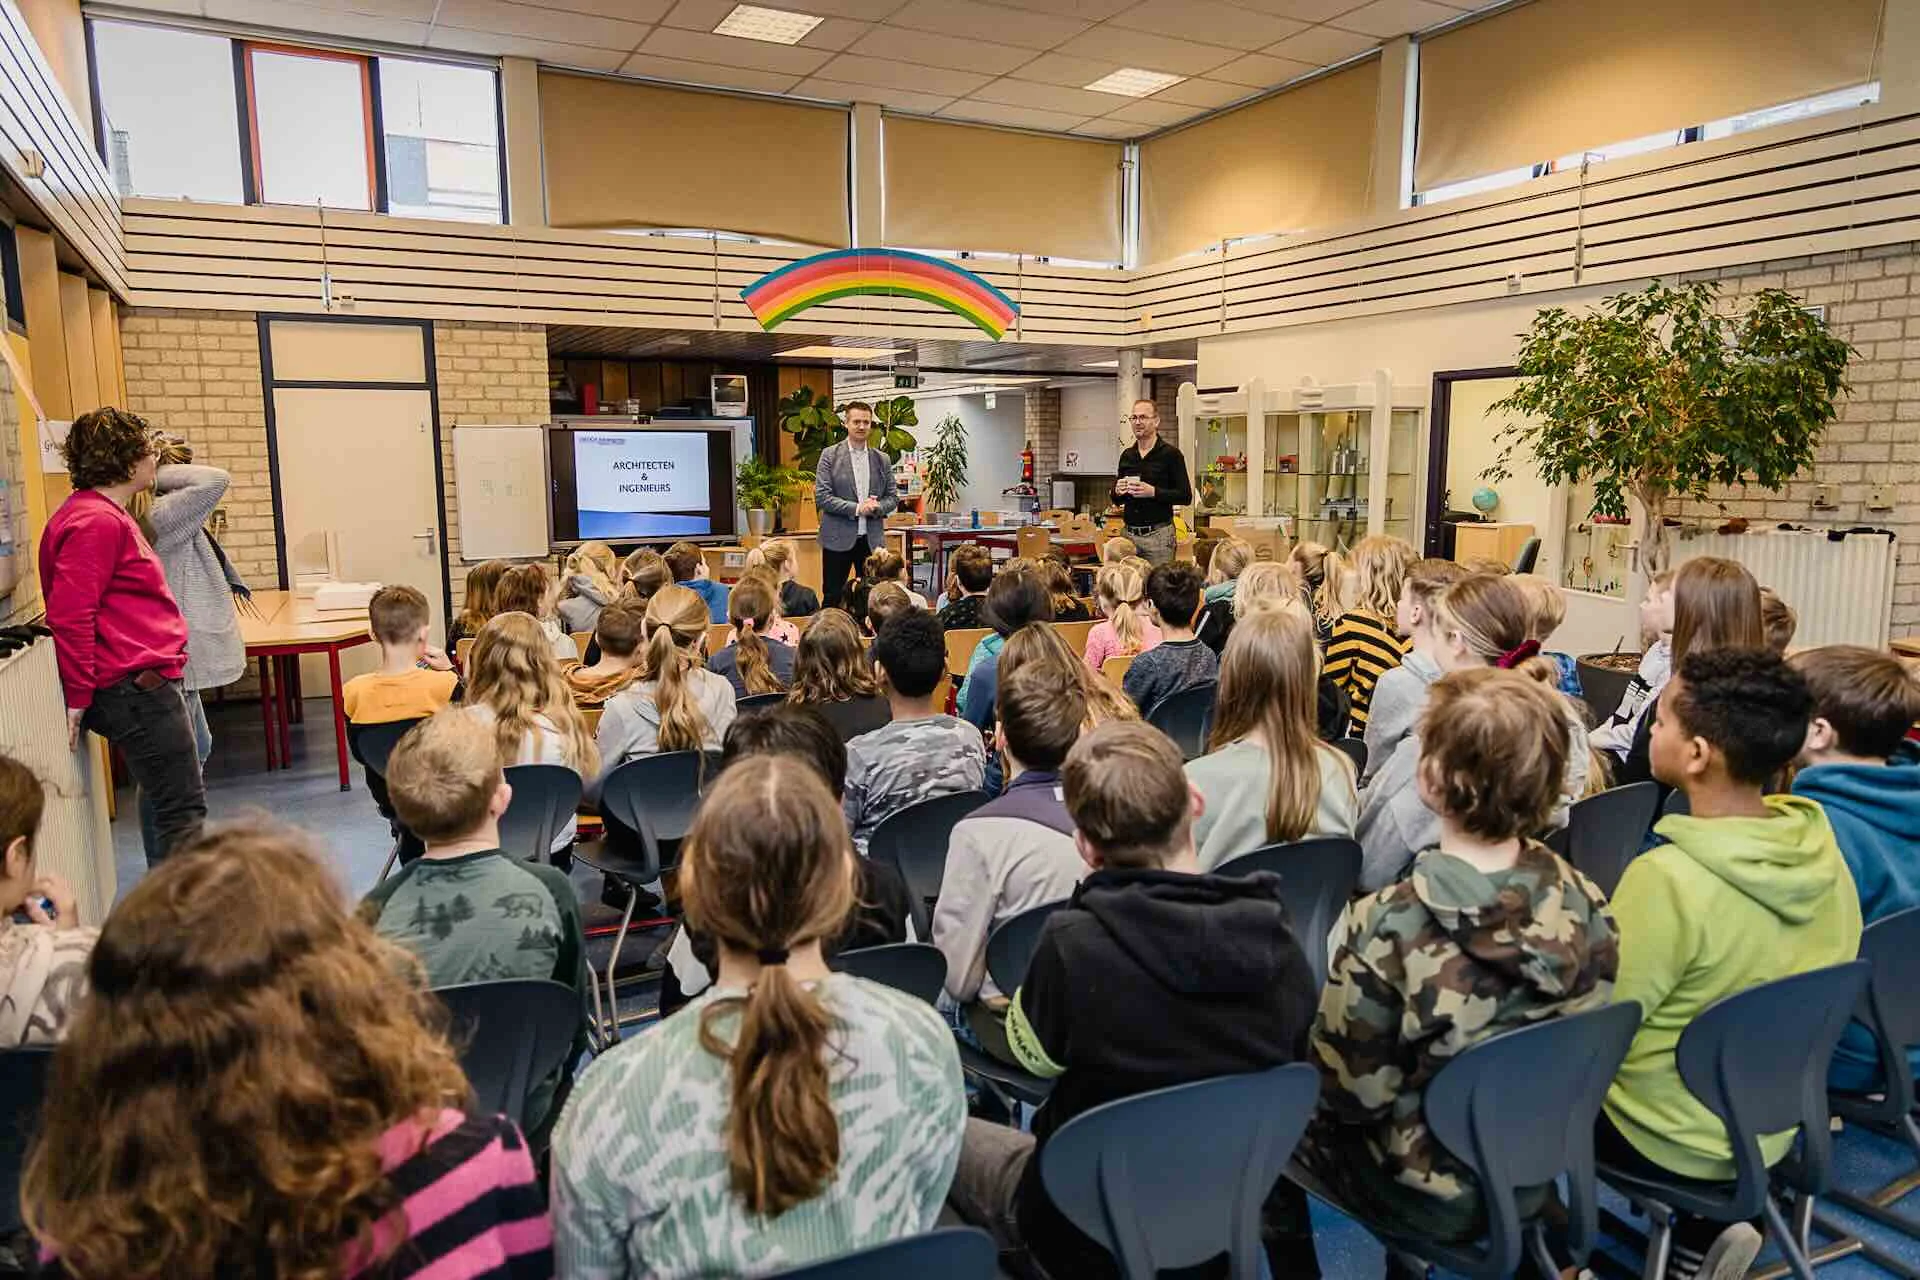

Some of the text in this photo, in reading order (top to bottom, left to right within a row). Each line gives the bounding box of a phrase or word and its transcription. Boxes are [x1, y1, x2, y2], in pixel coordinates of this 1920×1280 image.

[612, 461, 675, 471] ARCHITECTEN
[640, 472, 648, 481] &
[619, 483, 671, 493] INGENIEURS
